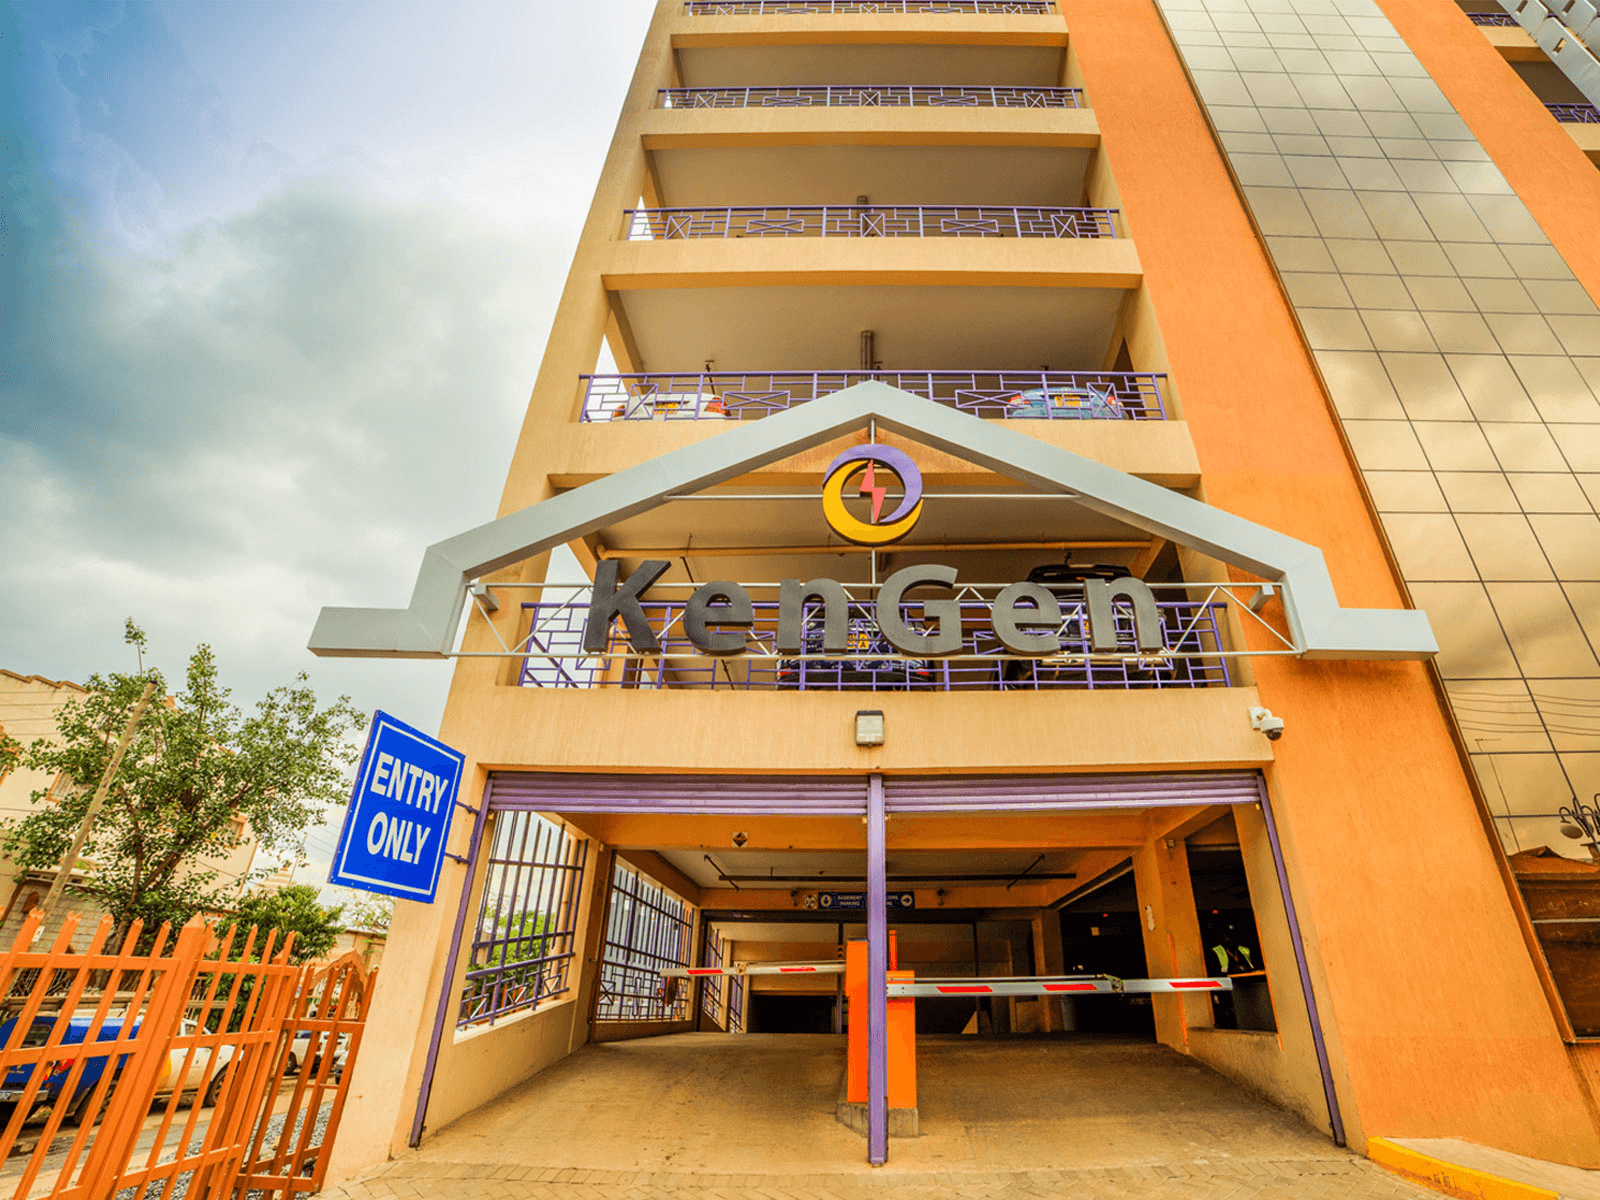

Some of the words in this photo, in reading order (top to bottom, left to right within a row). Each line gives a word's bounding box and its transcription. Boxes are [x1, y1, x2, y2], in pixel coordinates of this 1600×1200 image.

[583, 560, 1163, 657] KenGen
[370, 751, 449, 814] ENTRY
[367, 811, 431, 865] ONLY
